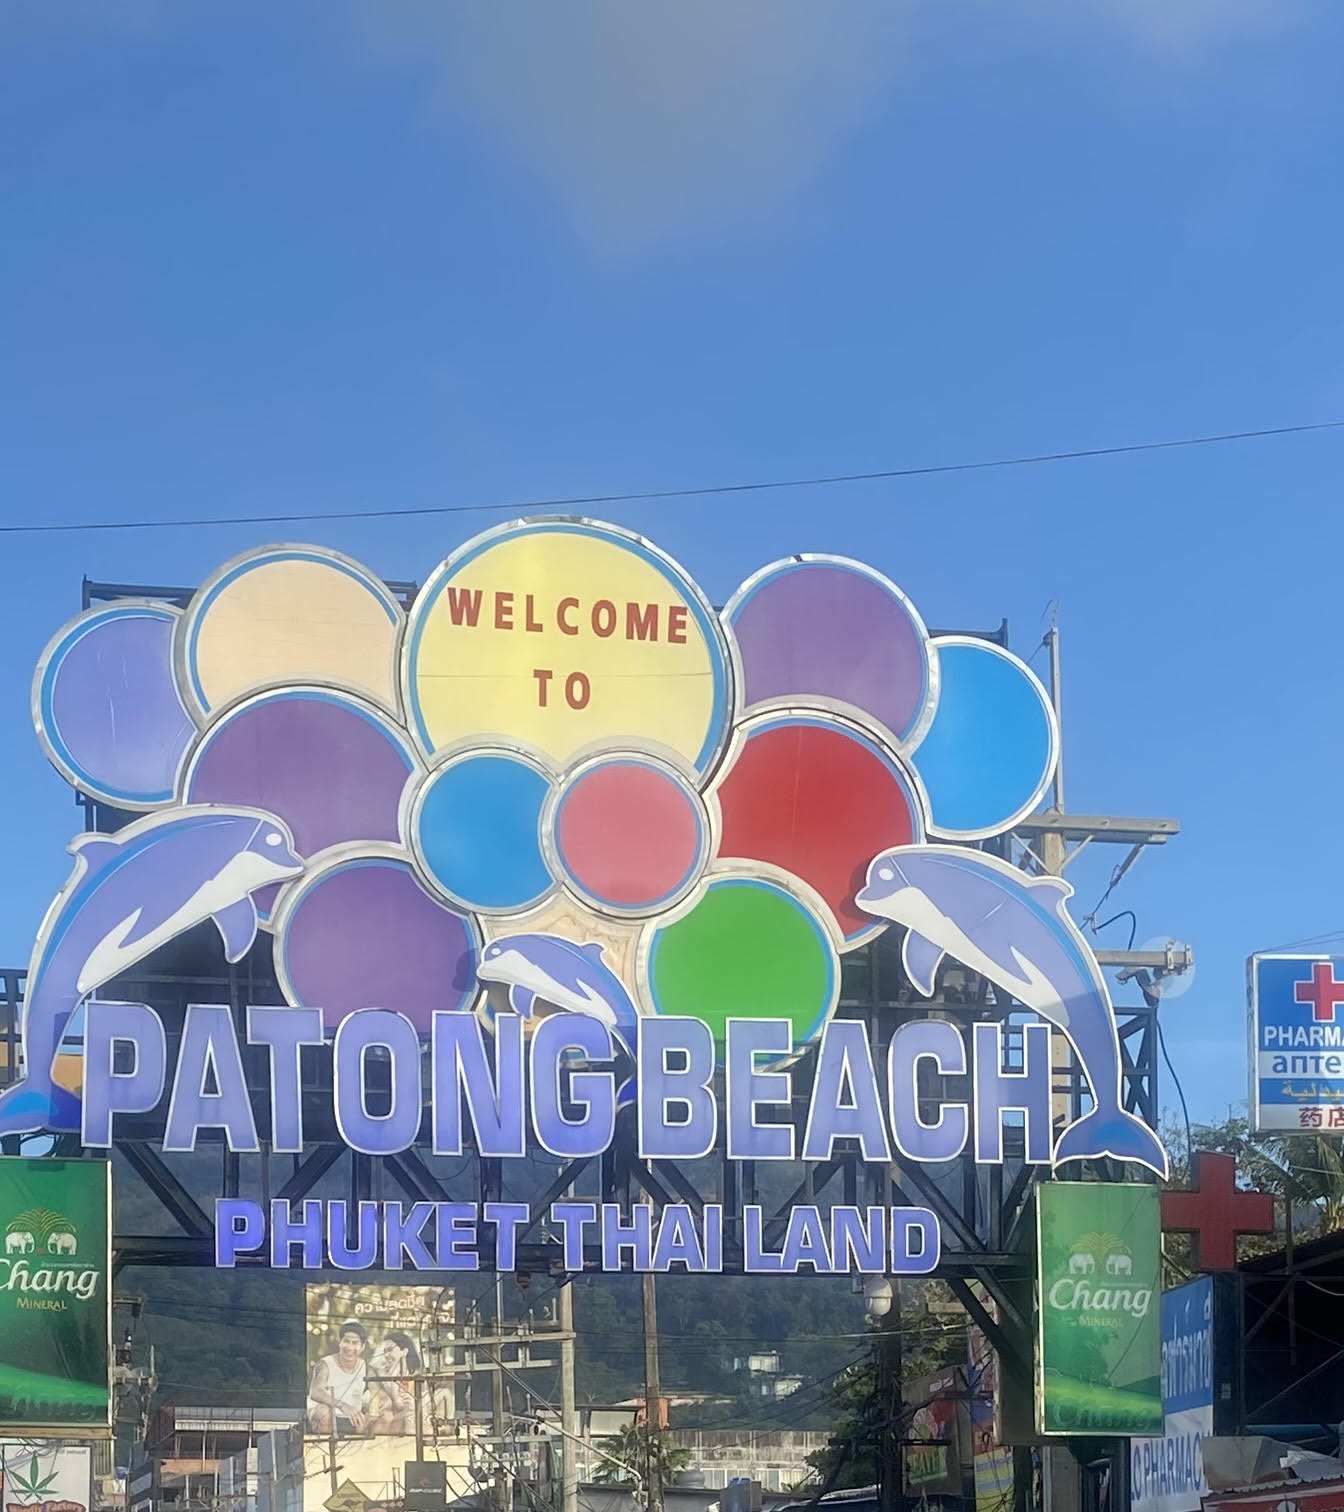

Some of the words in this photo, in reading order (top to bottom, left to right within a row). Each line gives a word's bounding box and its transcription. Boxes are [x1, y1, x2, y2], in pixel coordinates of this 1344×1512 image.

[447, 586, 688, 645] WELCOME
[533, 668, 591, 710] TO
[80, 1001, 618, 1160] PATONG
[638, 1015, 1053, 1166] BEACH
[215, 1197, 529, 1274] PHUKET
[16, 1297, 68, 1312] MINERAL
[1049, 1278, 1153, 1318] Chang
